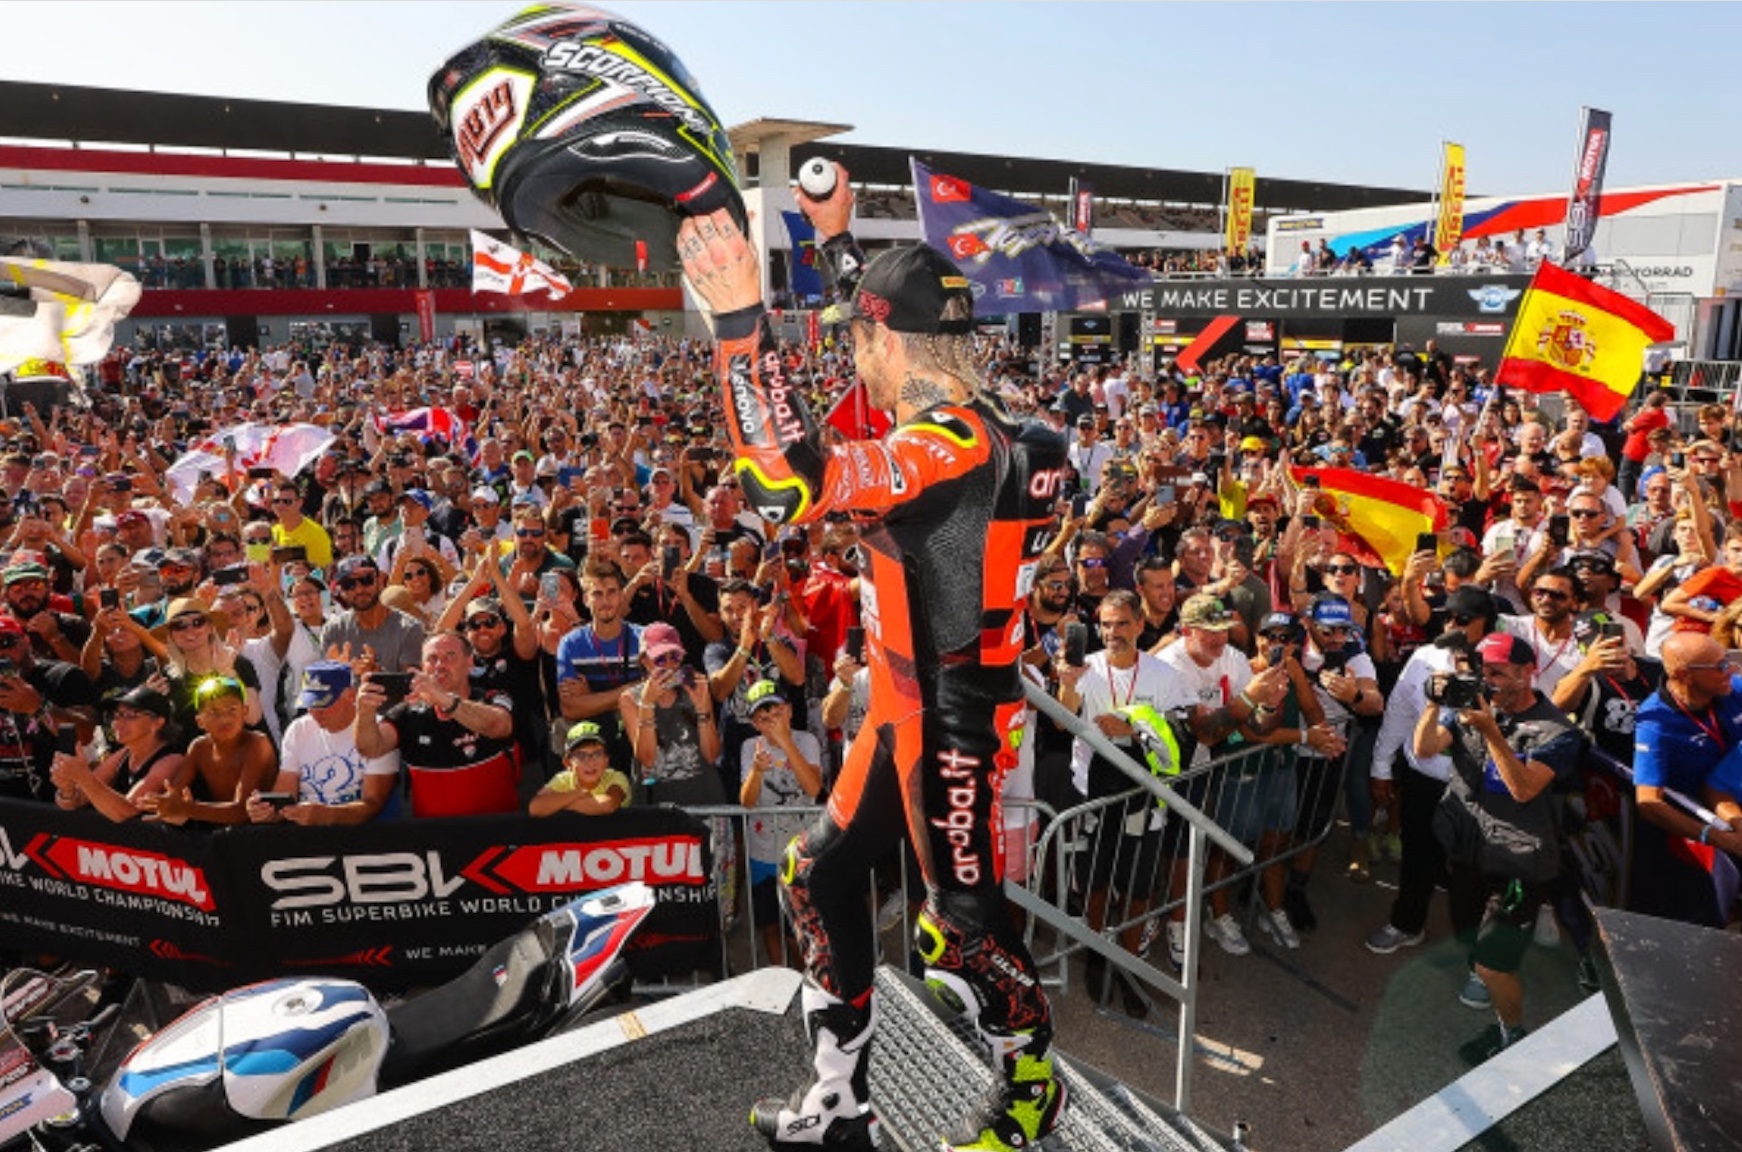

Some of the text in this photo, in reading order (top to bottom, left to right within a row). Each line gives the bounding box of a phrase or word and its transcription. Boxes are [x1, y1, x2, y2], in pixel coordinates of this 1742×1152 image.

[540, 38, 712, 136] SCORPION
[1582, 132, 1601, 181] MOTUL
[1122, 287, 1434, 310] WE MAKE EXCITEMENT
[931, 748, 981, 886] aruba.it
[76, 844, 207, 904] MOTUL
[535, 842, 704, 886] MOTUL
[28, 875, 89, 901] WORLD
[270, 910, 314, 928] FIM
[322, 901, 452, 924] SUPERBIKE
[459, 893, 542, 915] WORLD
[405, 944, 488, 960] WE MAKE
